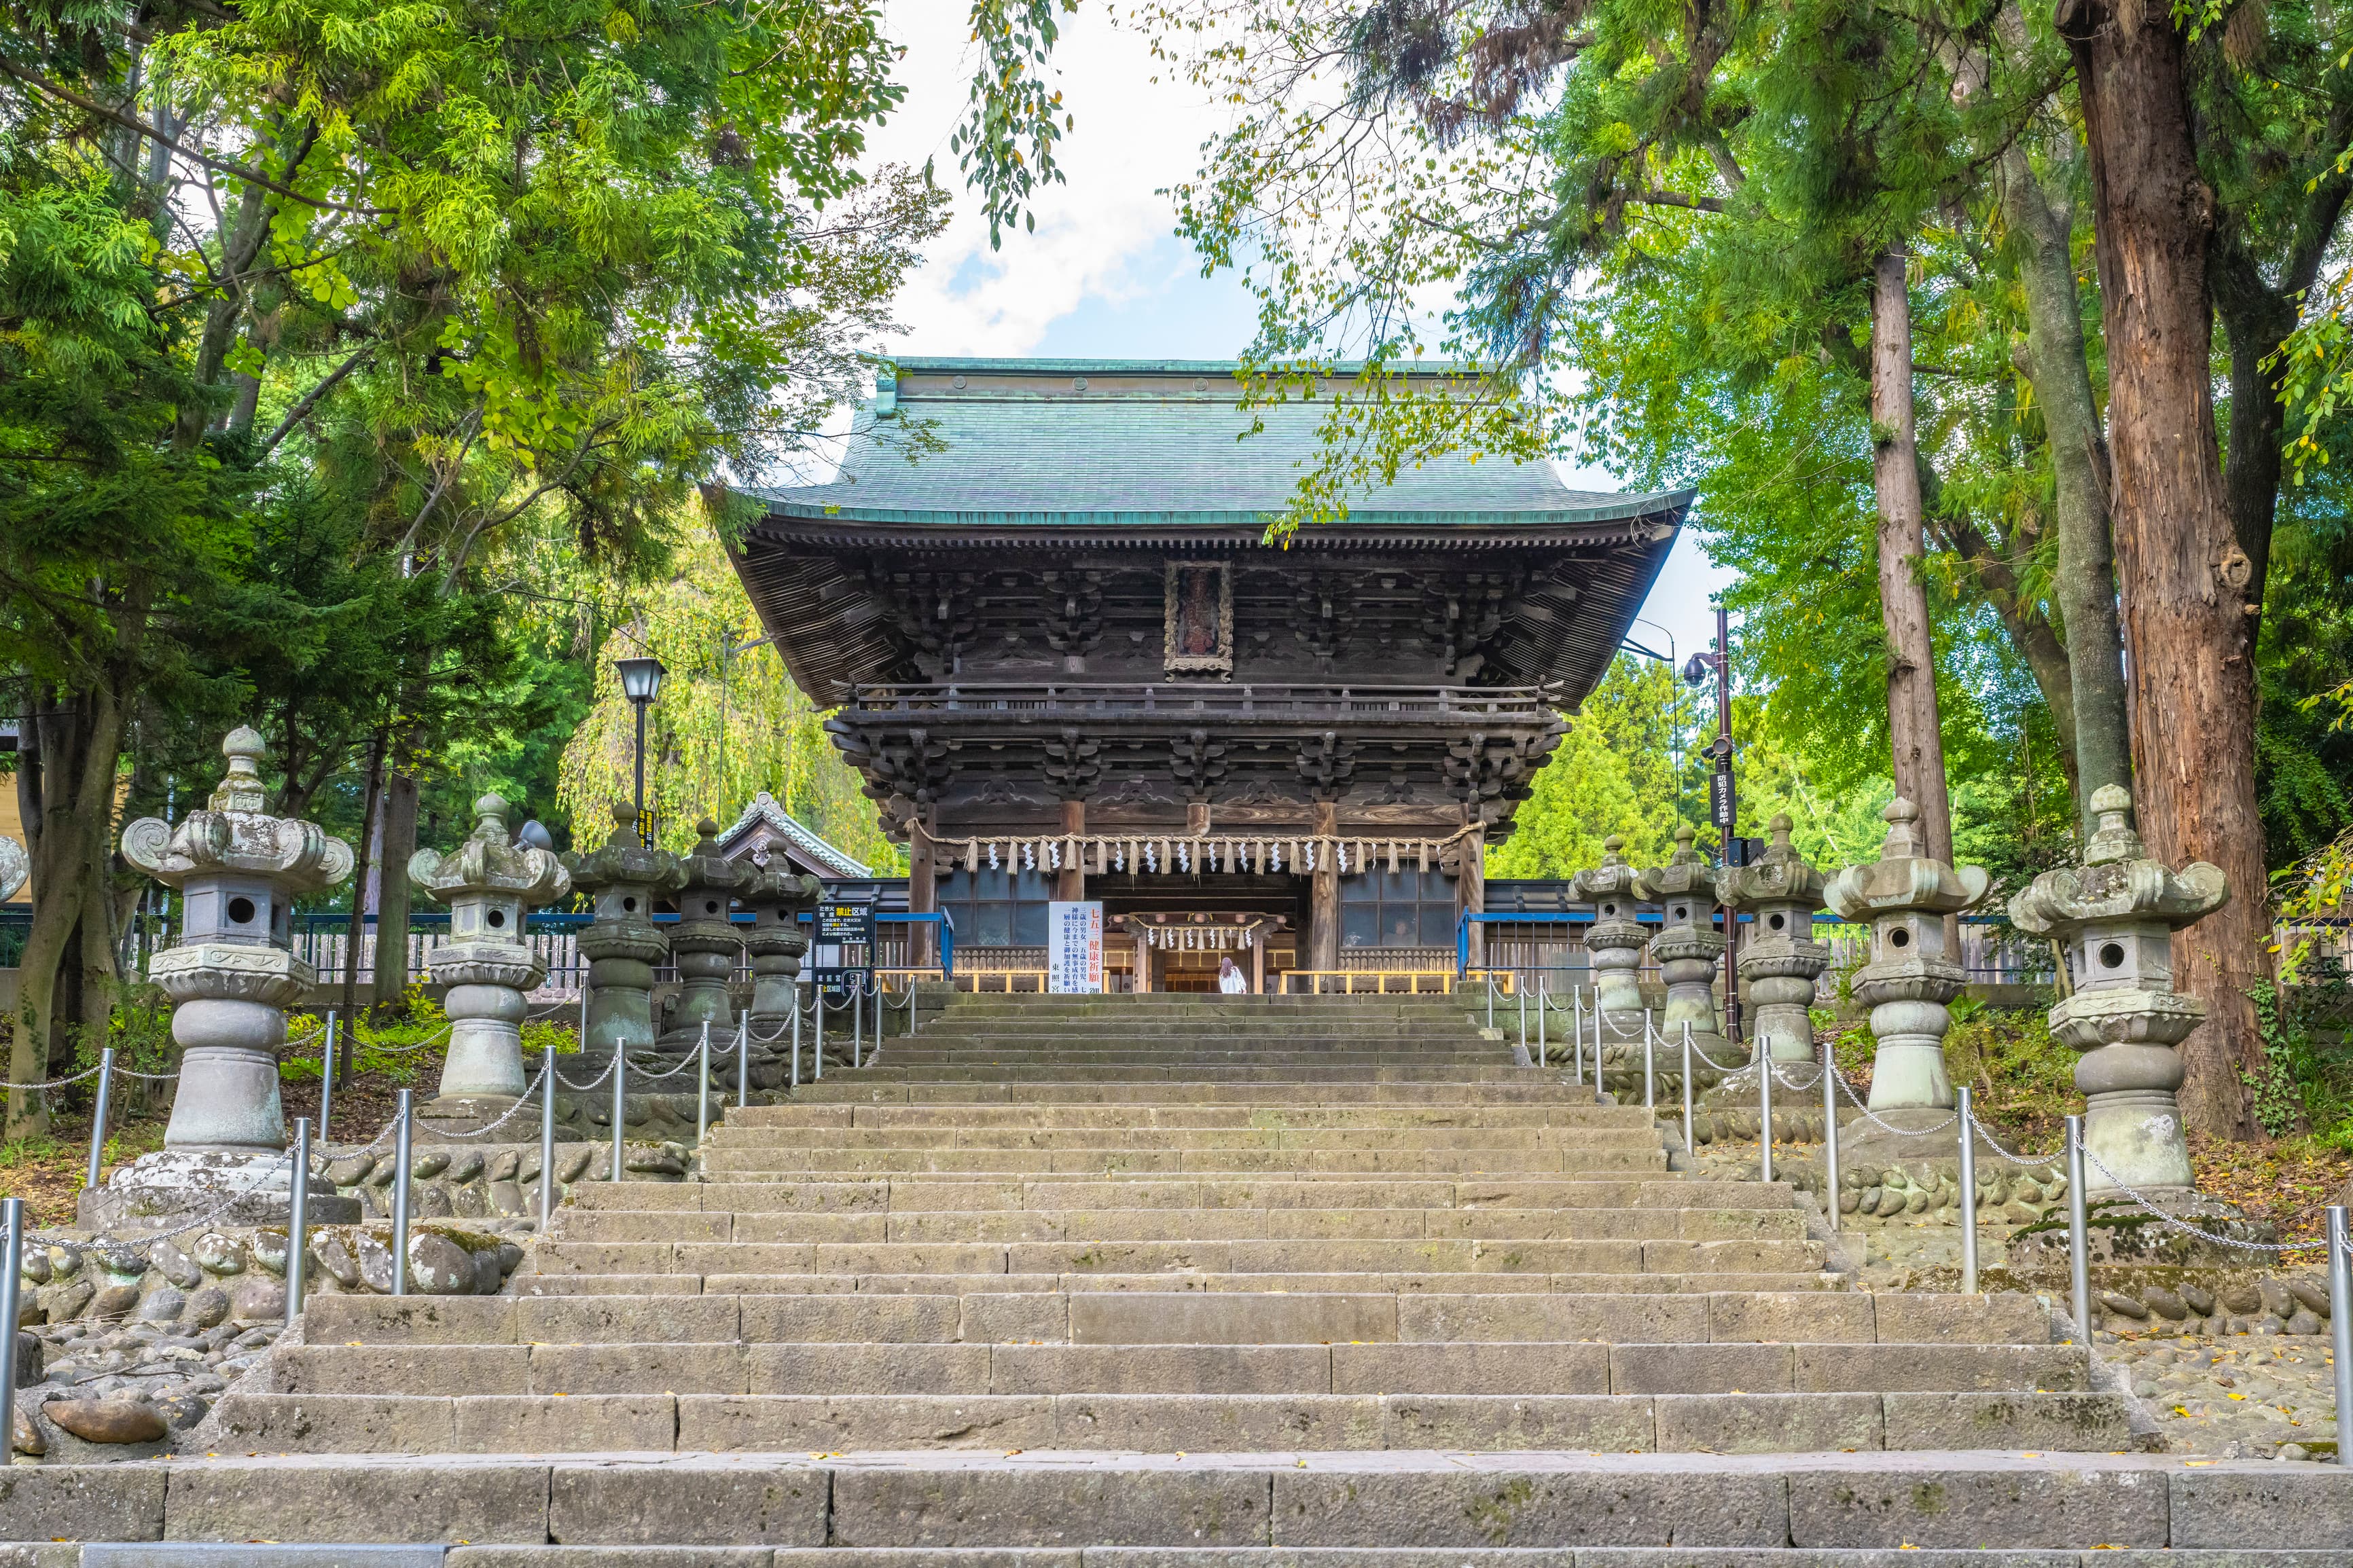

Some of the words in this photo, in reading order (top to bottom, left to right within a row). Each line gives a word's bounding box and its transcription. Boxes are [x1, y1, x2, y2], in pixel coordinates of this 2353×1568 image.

[1717, 775, 1729, 824] 防犯カメラ作動中
[836, 907, 868, 916] 禁止区域
[1089, 909, 1100, 983] 七五三健康祈願
[1052, 963, 1060, 993] 東照宮
